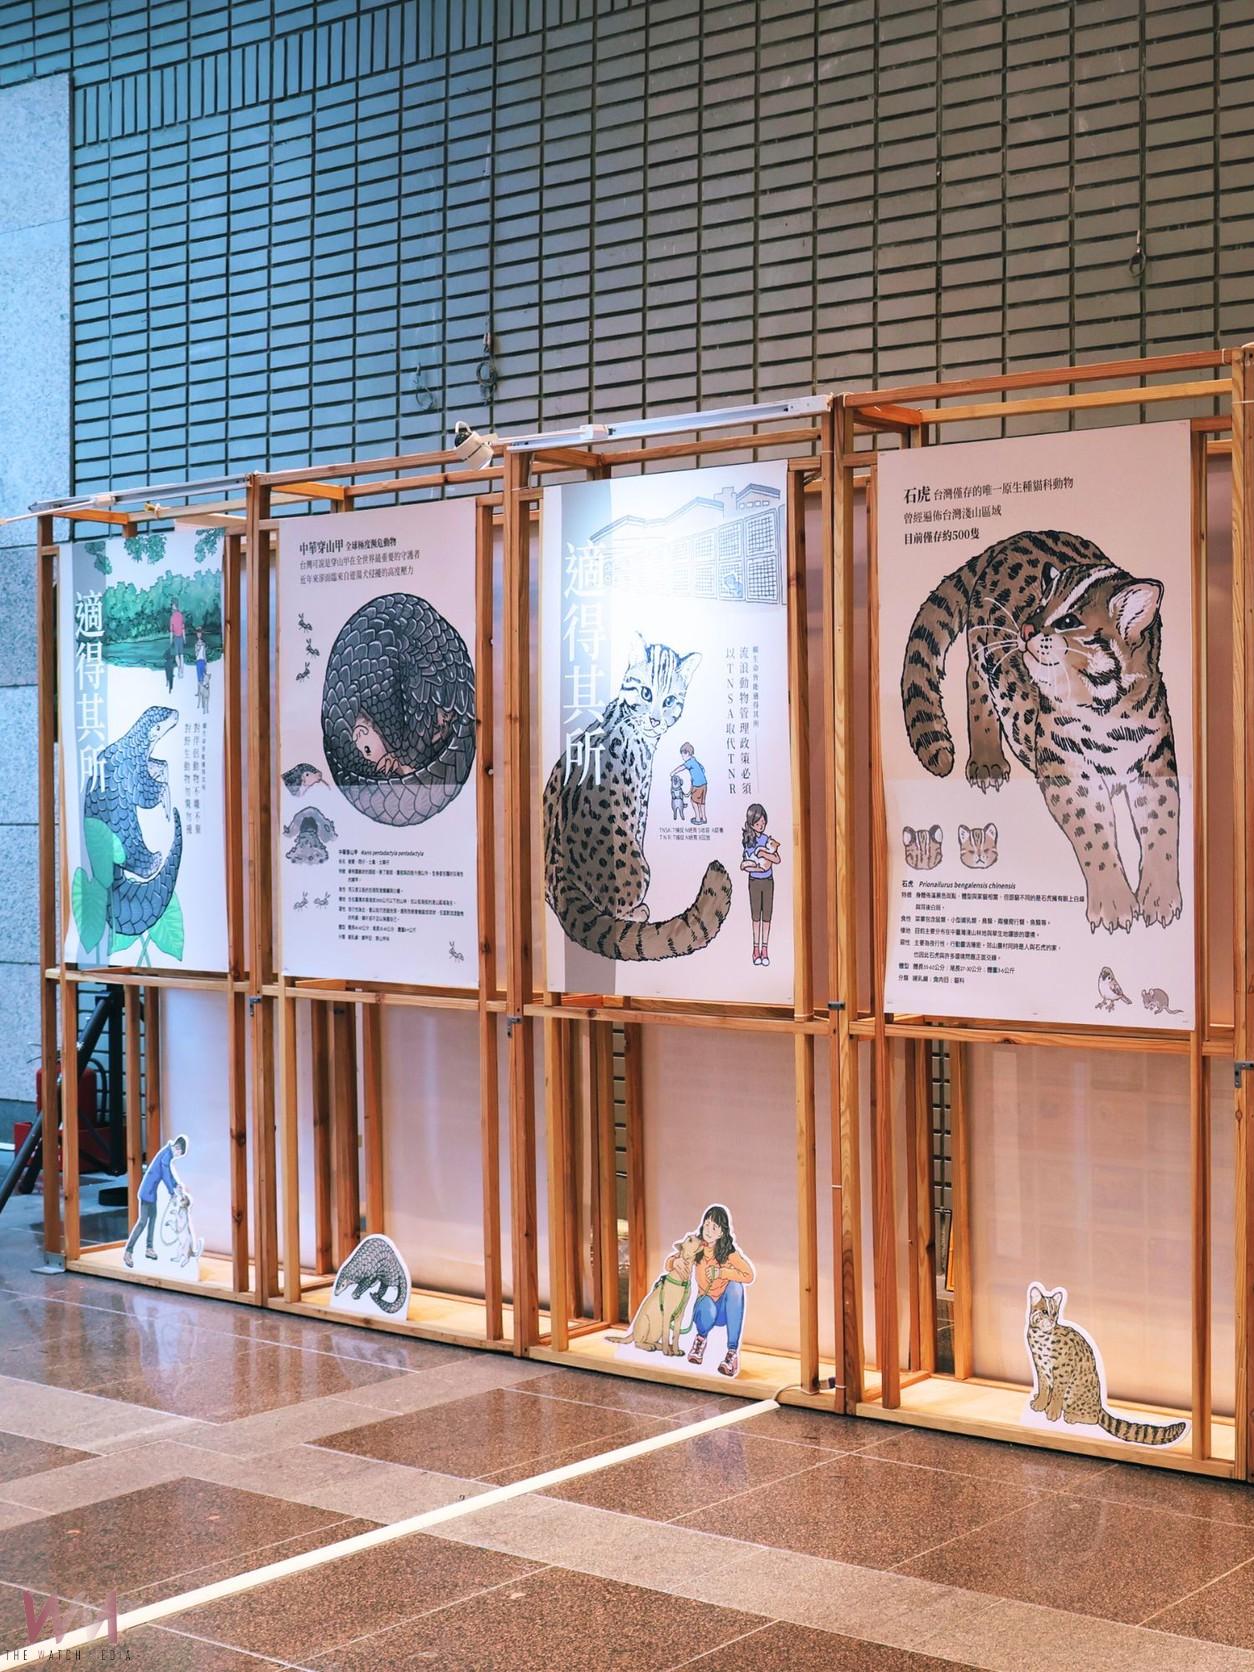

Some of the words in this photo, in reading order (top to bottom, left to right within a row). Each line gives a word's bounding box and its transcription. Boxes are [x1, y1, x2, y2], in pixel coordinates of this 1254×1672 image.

[903, 485, 931, 505] 石虎
[934, 476, 1075, 501] 台灣僅存的唯一原生種貓科動物
[903, 504, 1002, 524] 曾經遍佈台灣淺山區域
[299, 538, 344, 556] 中華穿山甲
[904, 527, 980, 545] 目前僅存約500隻
[563, 539, 607, 787] 適得其所
[75, 589, 107, 793] 適得其所
[739, 646, 752, 795] 流浪動物管理政策必須
[902, 880, 914, 888] 石虎
[954, 882, 987, 890] bengalensis
[988, 882, 1016, 890] chinensis
